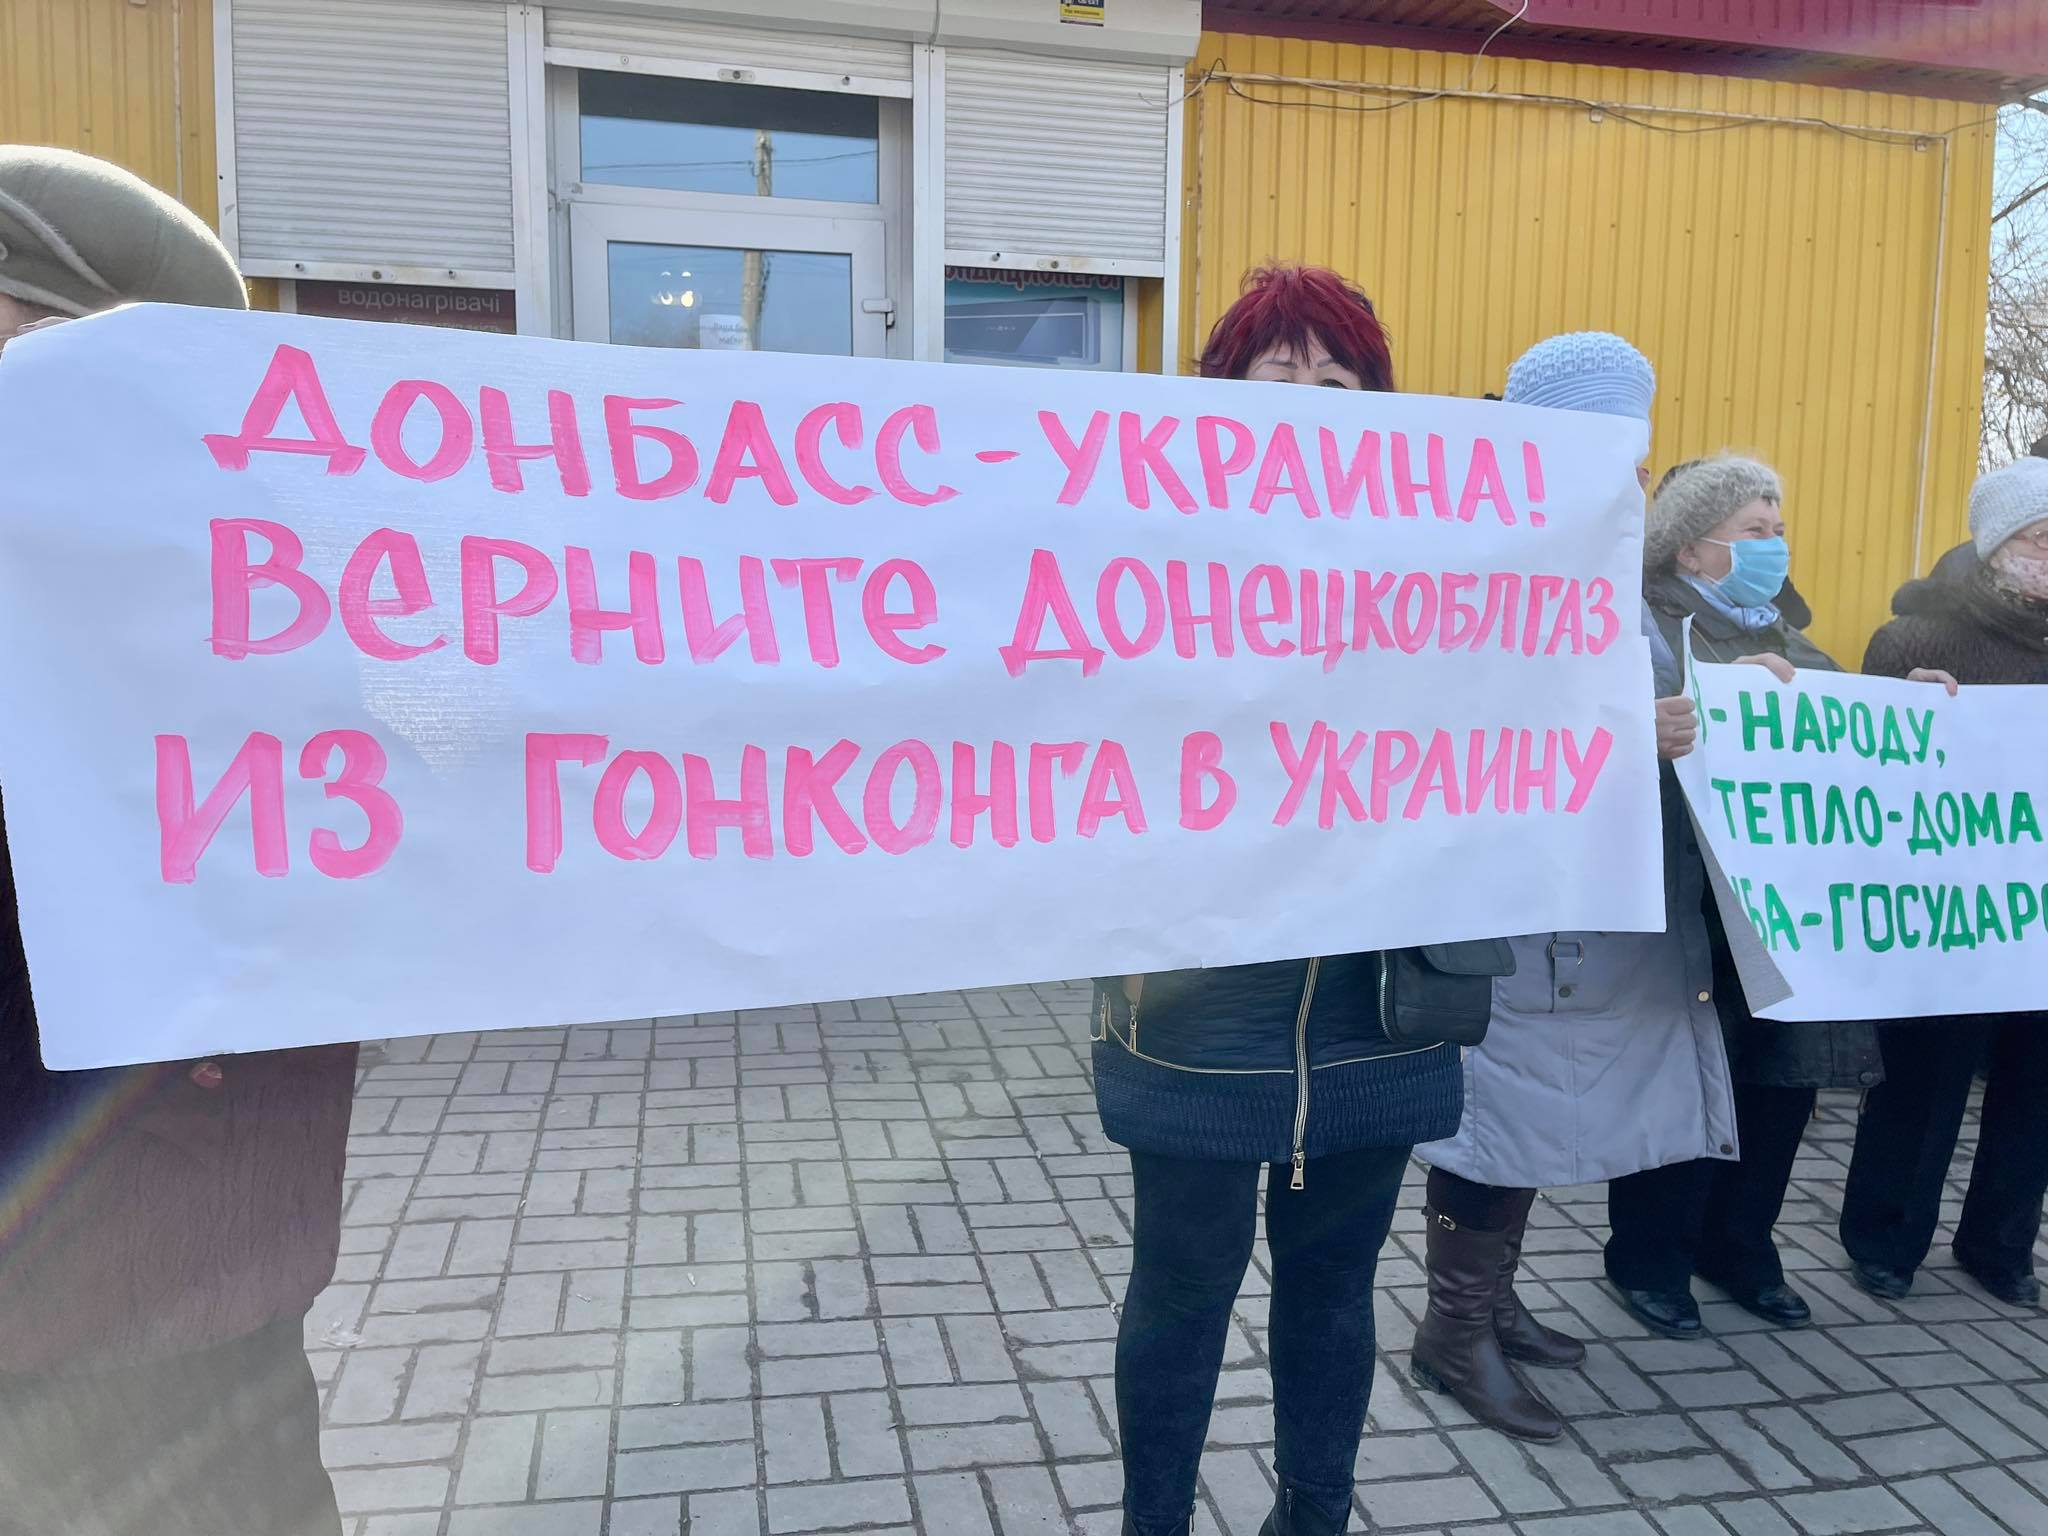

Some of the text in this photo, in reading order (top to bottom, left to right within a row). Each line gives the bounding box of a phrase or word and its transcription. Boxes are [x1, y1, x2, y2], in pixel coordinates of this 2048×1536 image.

[338, 289, 500, 314] водонагрівачі
[154, 719, 1614, 884] ИЗ ГОНКОНГА В УКРАИНУ
